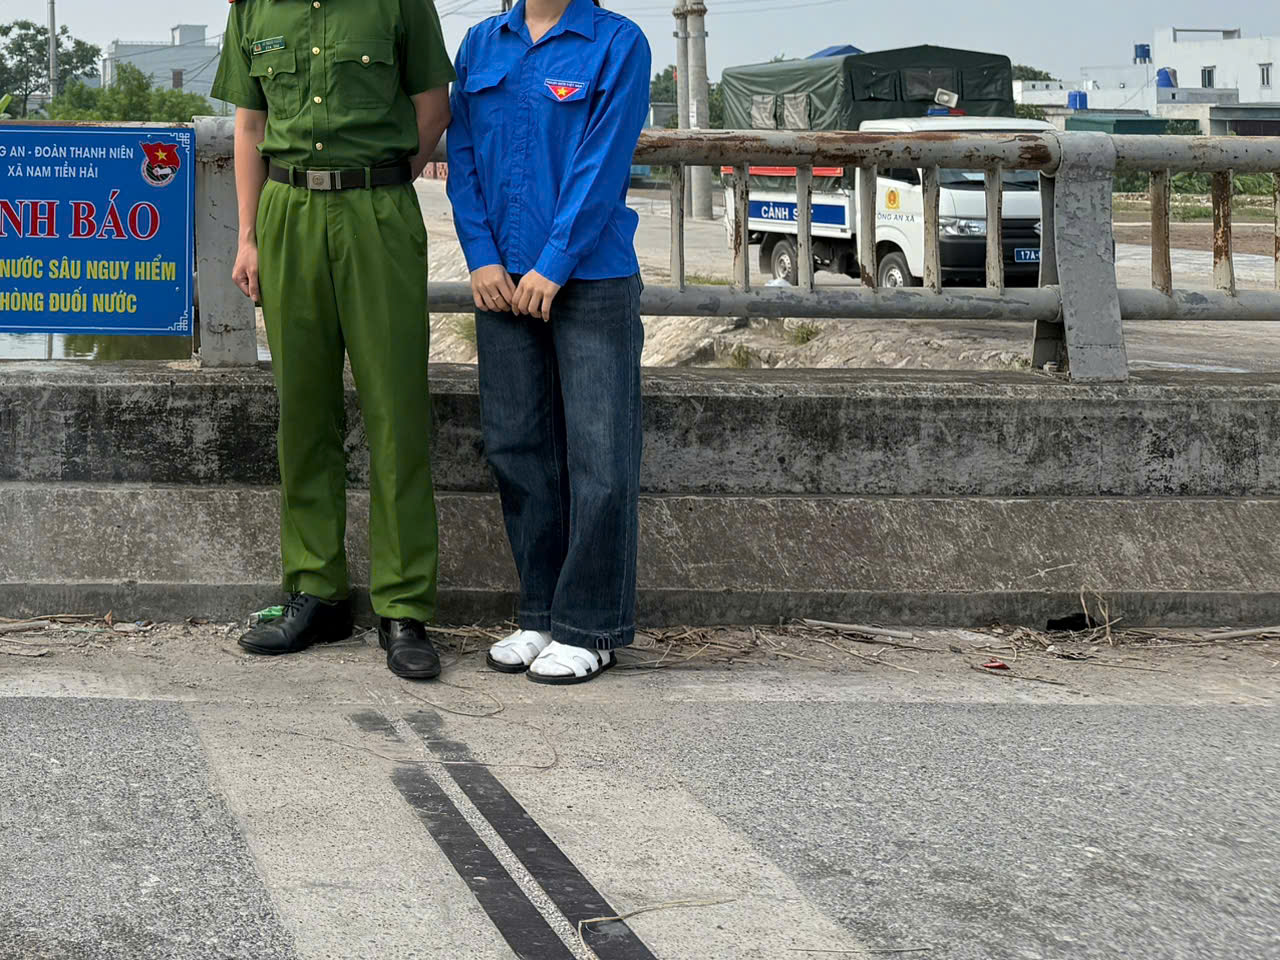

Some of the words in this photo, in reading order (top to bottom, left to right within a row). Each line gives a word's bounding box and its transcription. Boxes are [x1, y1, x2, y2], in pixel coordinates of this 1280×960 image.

[9, 145, 25, 157] AN
[34, 144, 67, 158] ĐOÀN
[70, 146, 106, 159] THANH
[109, 144, 134, 159] NIÊN
[7, 162, 23, 177] XÃ
[26, 165, 51, 177] NAM
[54, 160, 76, 178] TIỀN
[79, 162, 98, 178] HẢI
[68, 189, 160, 240] BÁO
[761, 203, 789, 219] CẢNH
[0, 255, 44, 279] NƯỚC
[48, 256, 81, 280] SÂU
[86, 260, 130, 280] NGUY
[135, 254, 176, 281] HIỂM
[49, 286, 87, 313] ĐUỐI
[92, 289, 137, 313] NƯỚC
